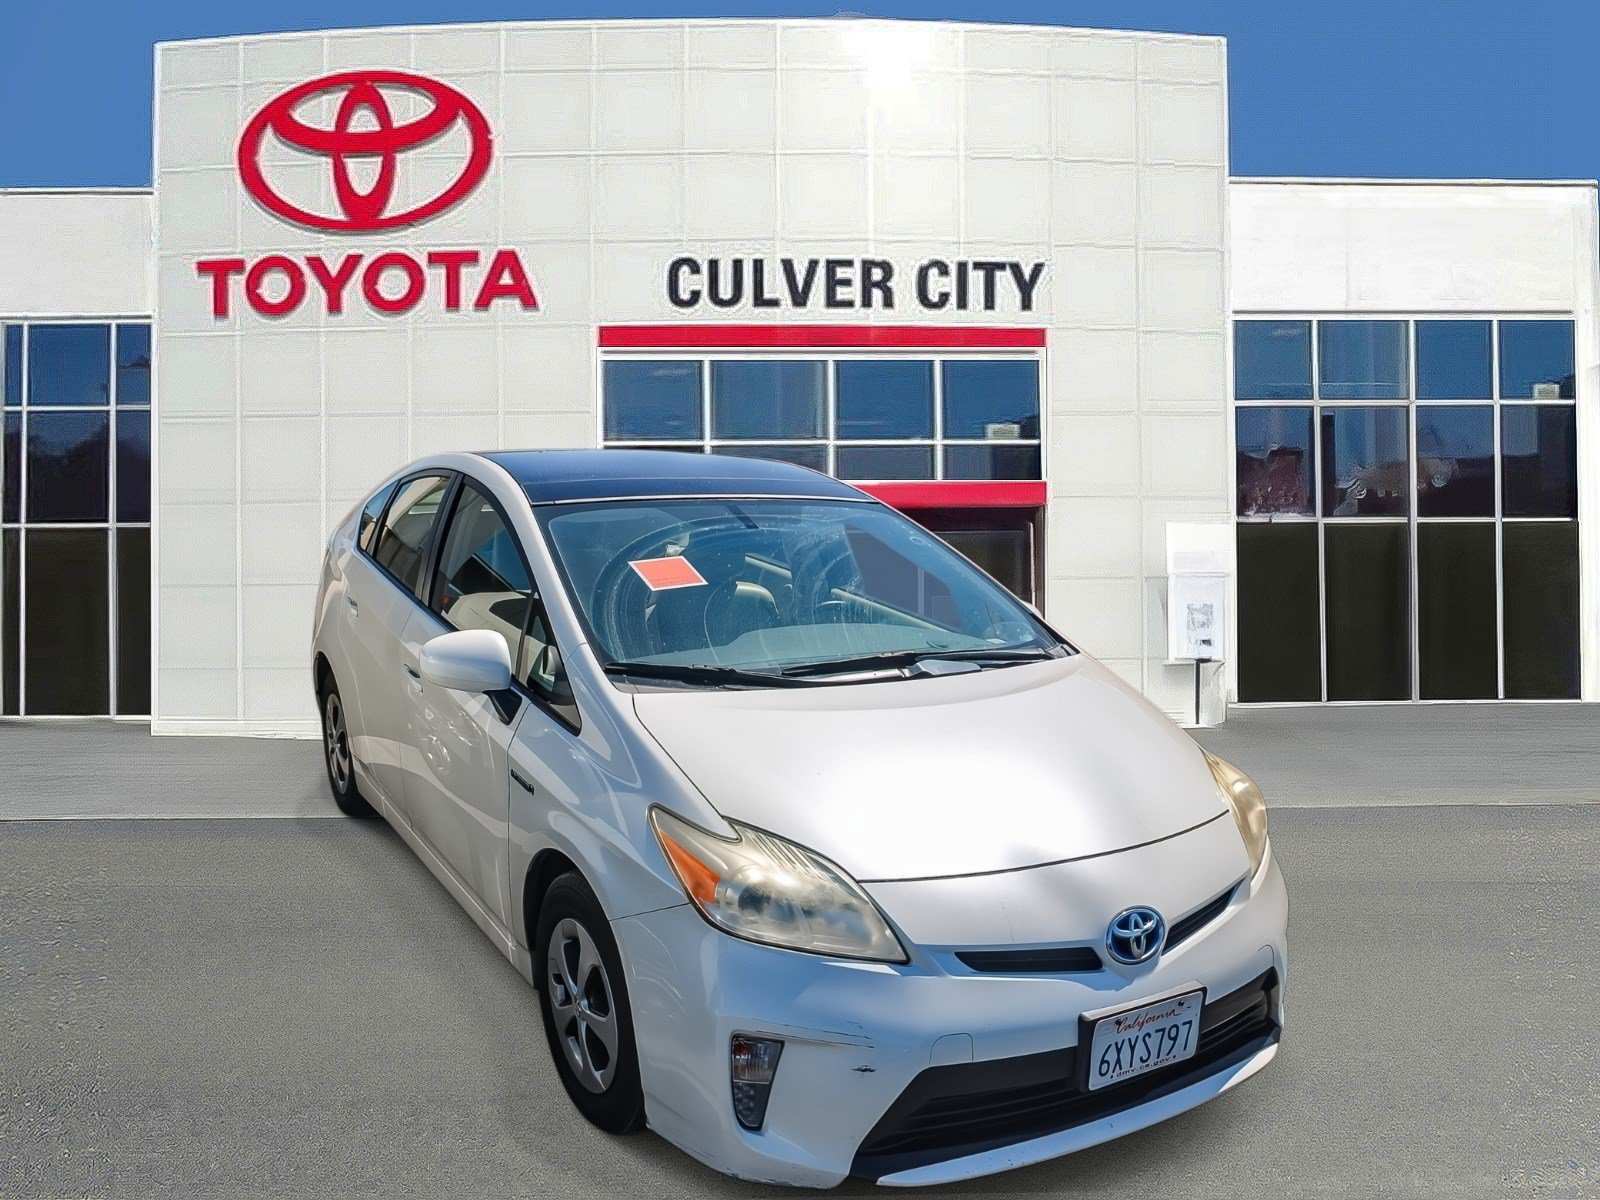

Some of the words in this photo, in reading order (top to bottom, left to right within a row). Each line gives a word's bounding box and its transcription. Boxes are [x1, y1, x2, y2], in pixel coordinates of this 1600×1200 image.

[197, 249, 539, 318] TOYOTA
[667, 257, 895, 308] CULVER
[916, 258, 1046, 311] CITY
[1098, 1020, 1193, 1077] 6XYS797
[1116, 1009, 1182, 1034] California
